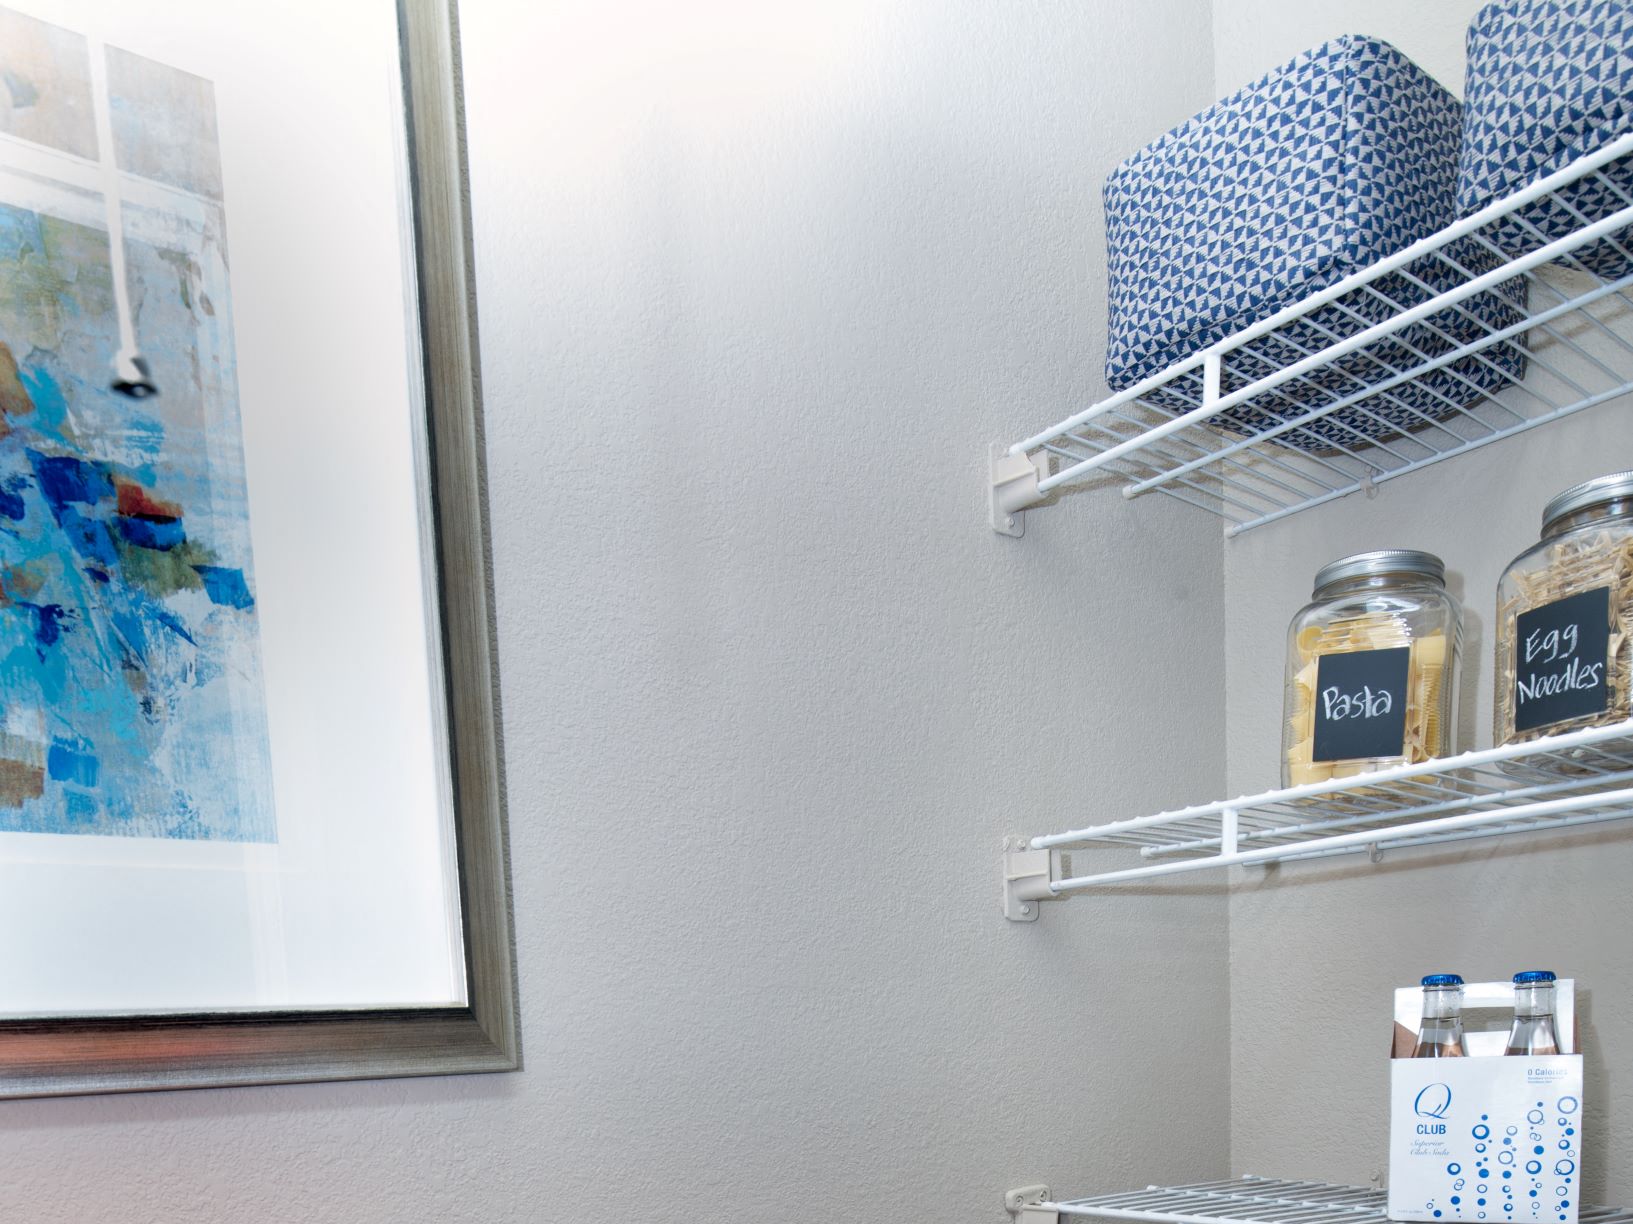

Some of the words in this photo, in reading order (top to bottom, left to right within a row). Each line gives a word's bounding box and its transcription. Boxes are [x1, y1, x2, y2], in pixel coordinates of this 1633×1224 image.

[1525, 624, 1579, 664] Egg
[1517, 658, 1603, 704] Noodles
[1322, 685, 1392, 721] Pasta
[1414, 1083, 1452, 1119] Q
[1416, 1124, 1447, 1135] CLUB
